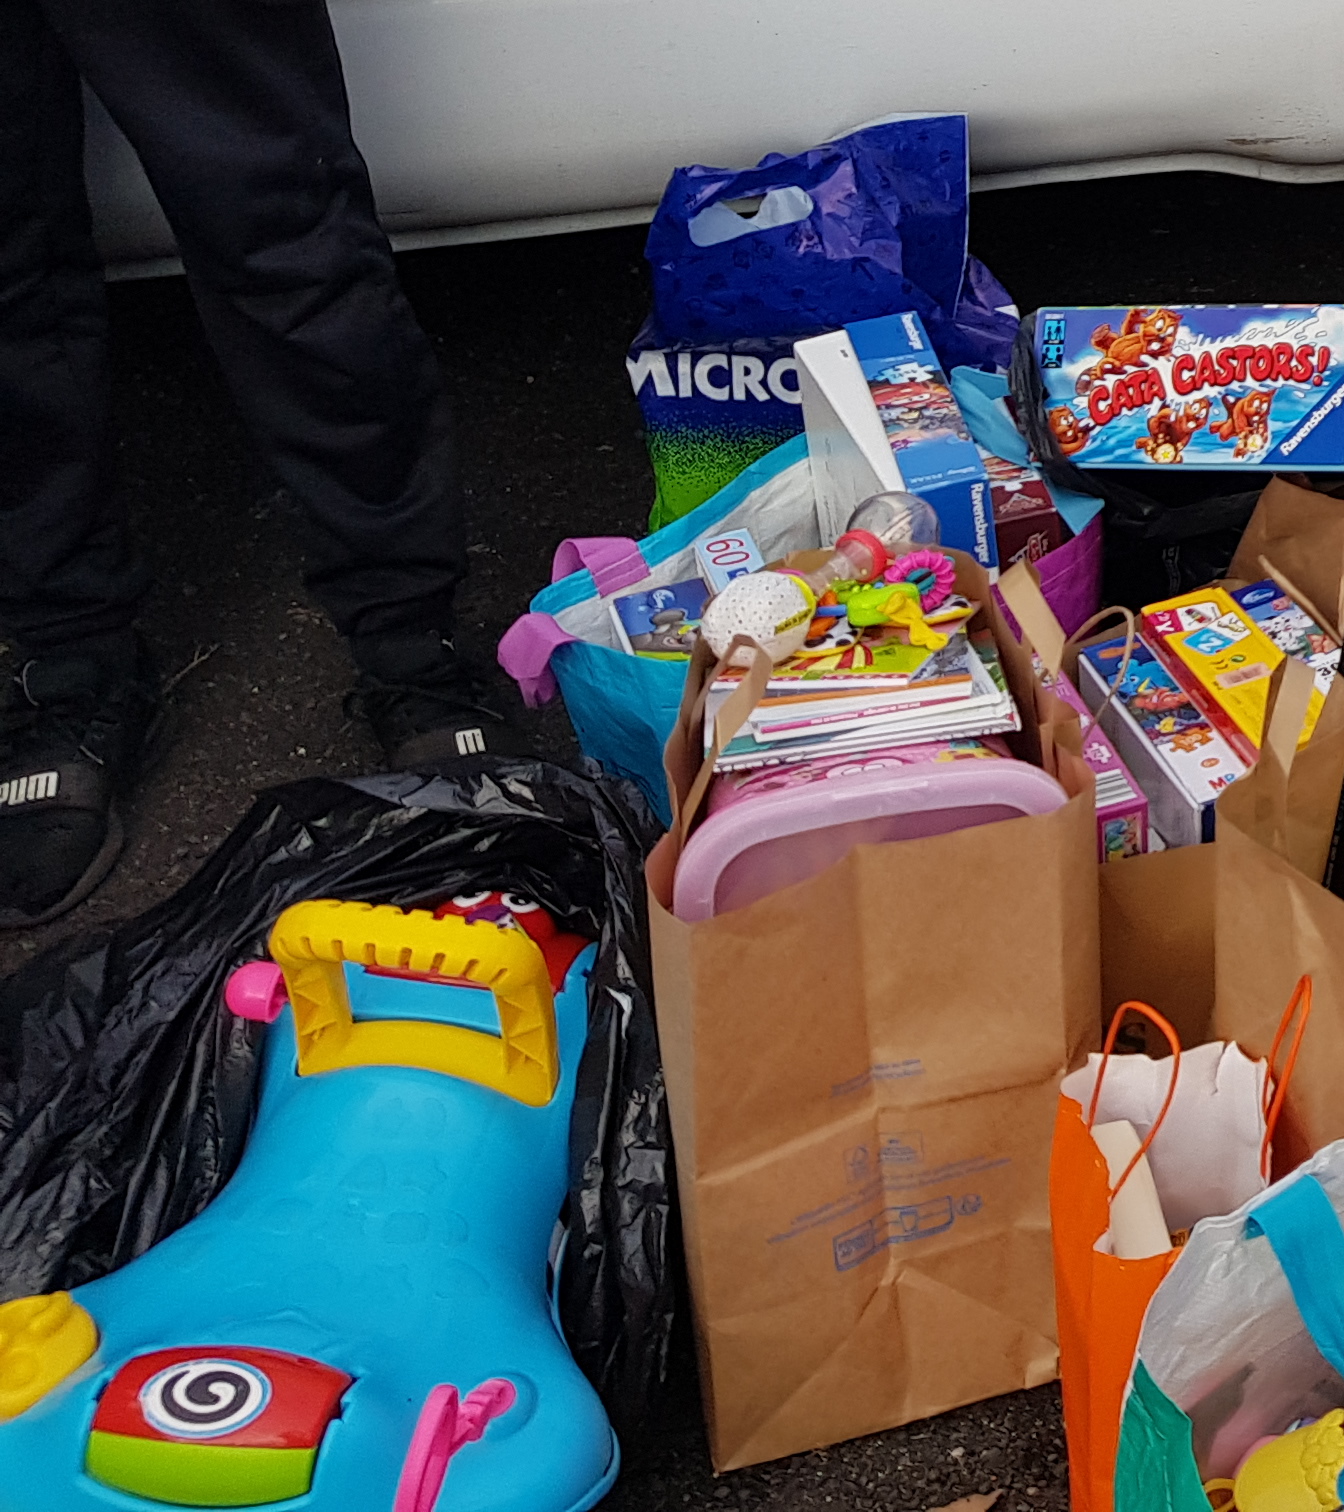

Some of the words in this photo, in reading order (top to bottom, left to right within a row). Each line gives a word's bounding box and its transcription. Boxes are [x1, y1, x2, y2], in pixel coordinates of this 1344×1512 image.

[627, 350, 802, 404] MICRO
[1088, 370, 1163, 425] CATA
[1172, 344, 1331, 390] CASTORS!
[970, 482, 992, 567] Ravensburger
